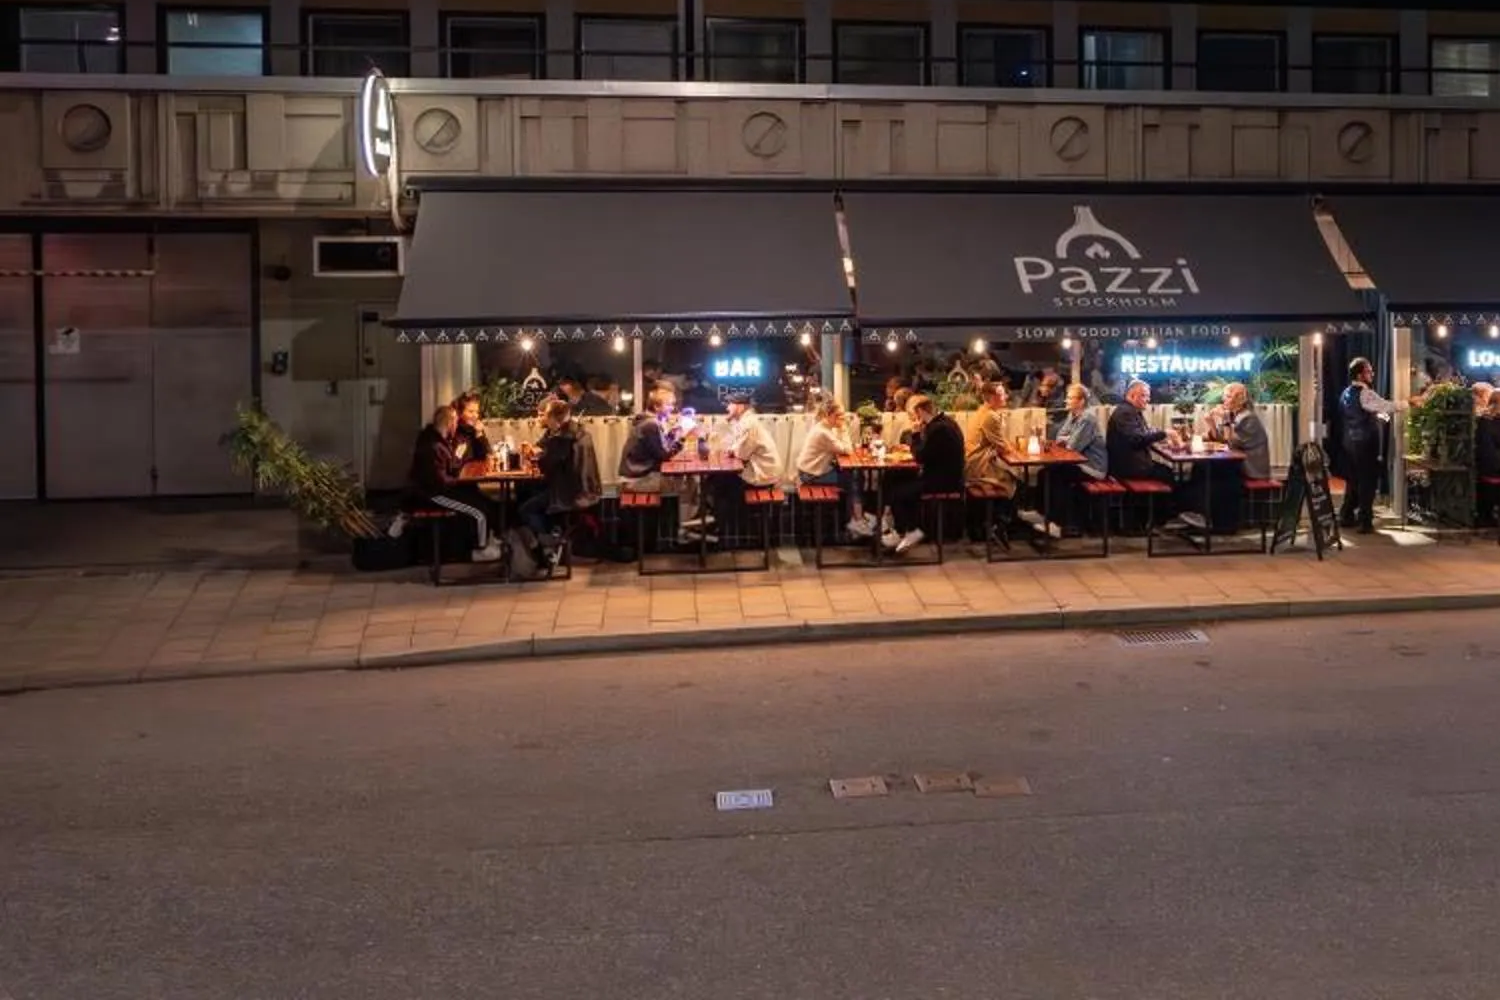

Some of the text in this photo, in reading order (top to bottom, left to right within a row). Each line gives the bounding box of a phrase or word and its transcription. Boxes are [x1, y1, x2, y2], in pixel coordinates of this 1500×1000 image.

[1013, 256, 1200, 294] Pazzi
[1053, 297, 1178, 308] STOCKHOLM
[1016, 327, 1056, 338] SLOW
[1079, 327, 1122, 337] GOOD
[1127, 325, 1186, 337] ITALIAN
[1191, 325, 1232, 336] FOOD
[714, 358, 762, 377] BAR
[1121, 353, 1256, 373] RESTAURANT
